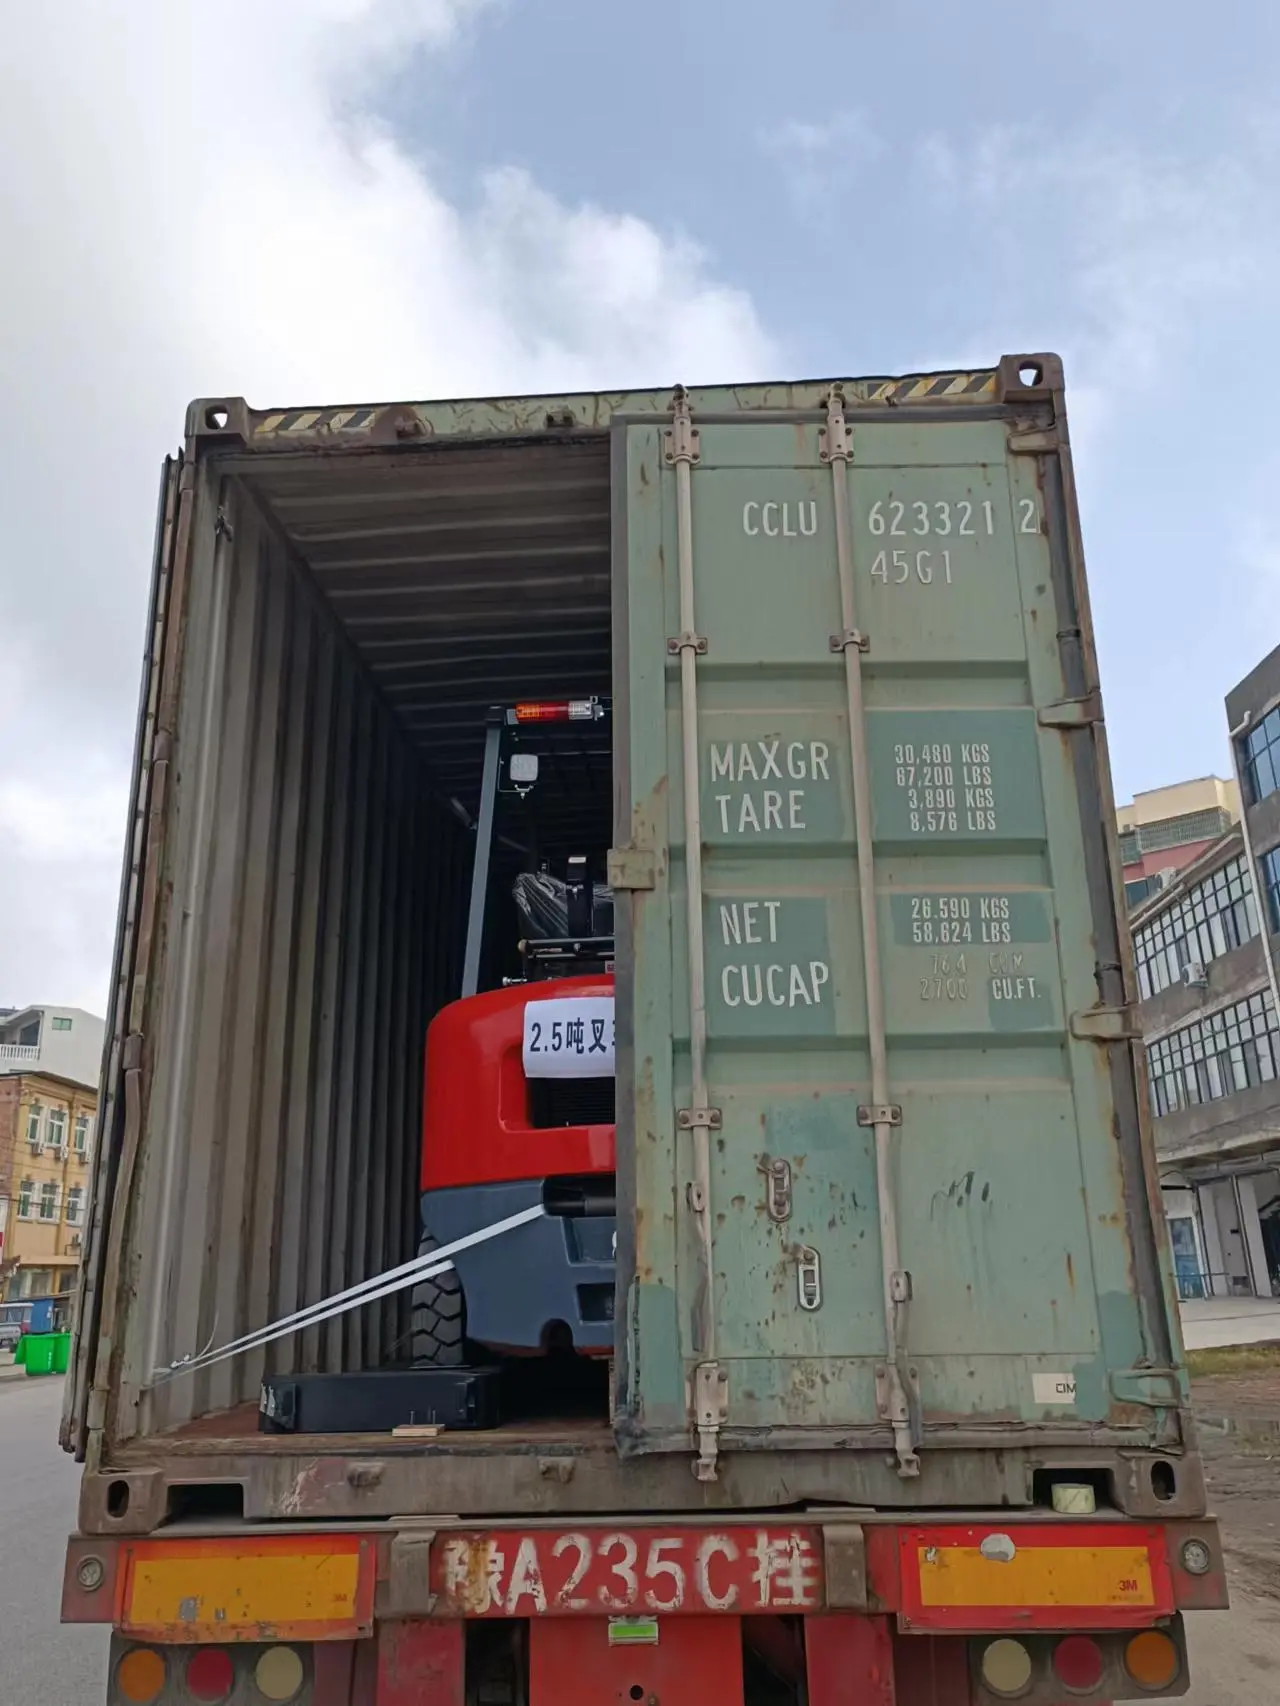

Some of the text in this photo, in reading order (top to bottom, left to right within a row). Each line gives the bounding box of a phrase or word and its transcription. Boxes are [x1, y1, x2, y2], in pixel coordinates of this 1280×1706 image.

[742, 499, 1038, 537] CCLU 623321 2
[870, 550, 953, 585] 45G1
[710, 741, 831, 783] MAXGR
[894, 743, 990, 764] 30,480 KGS
[963, 765, 992, 785] LBS
[715, 790, 806, 834] TARE
[907, 787, 995, 811] 3,890 KGS
[910, 810, 997, 832] 8,576 LBS
[980, 896, 1010, 919] KGS
[720, 901, 782, 945] NET
[912, 921, 1012, 944] 58,624 LBS
[721, 961, 830, 1008] CUCAP
[528, 1017, 616, 1055] 2.5吨叉
[1119, 1579, 1138, 1592] 3M
